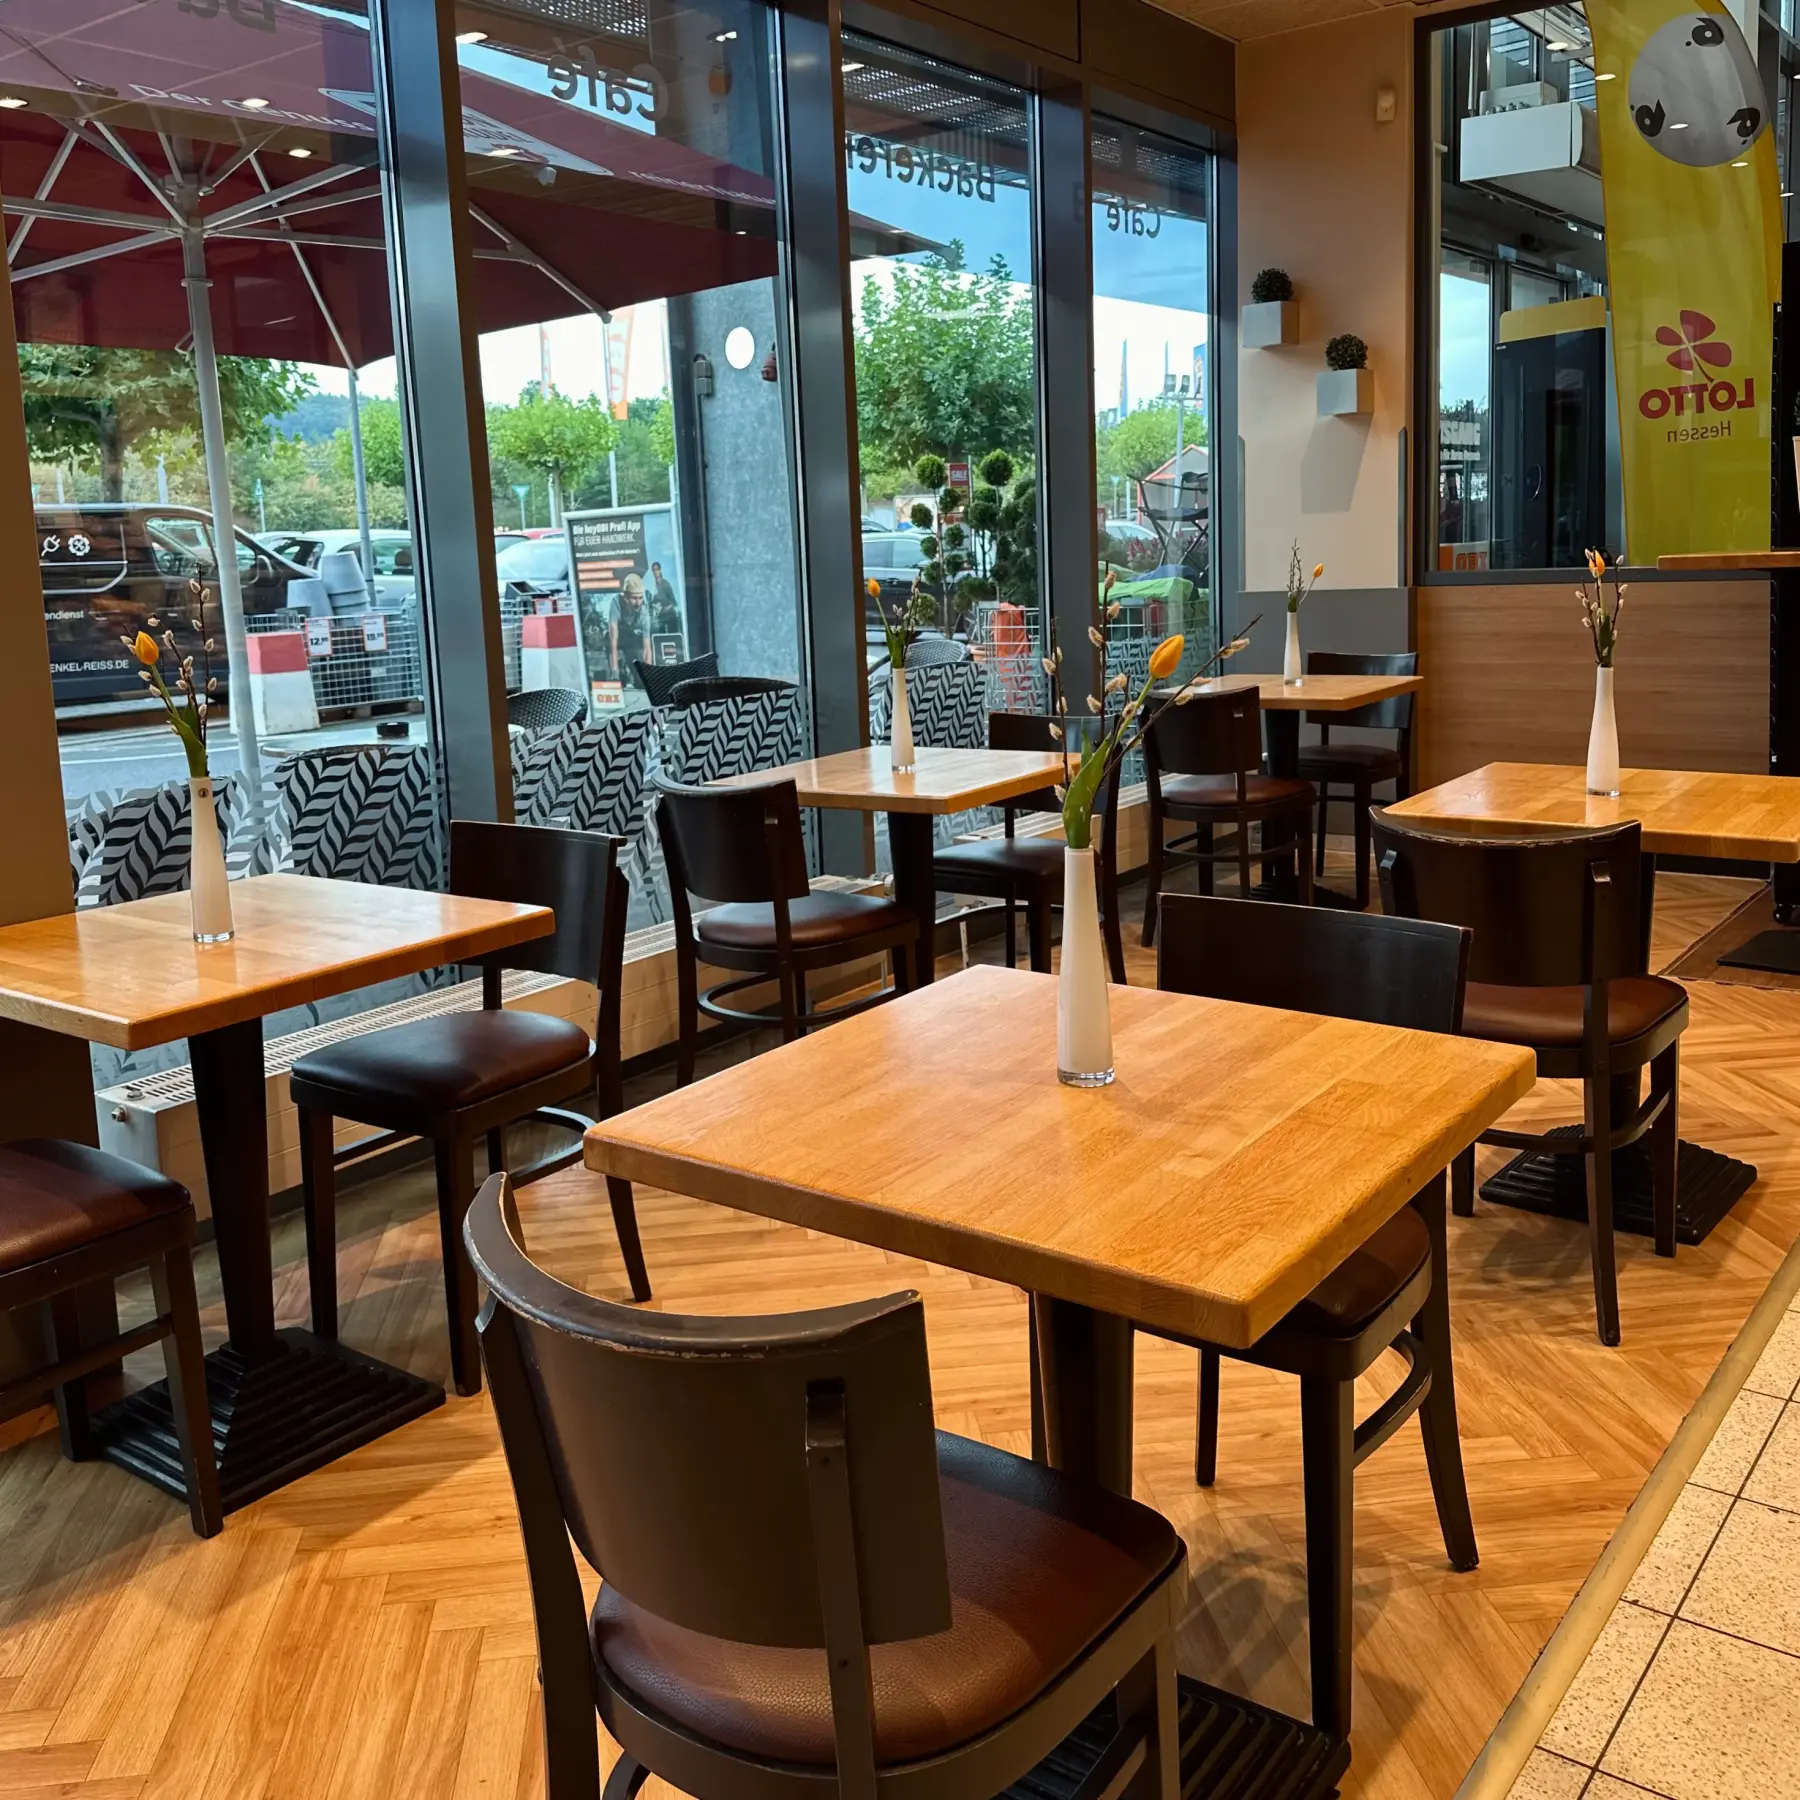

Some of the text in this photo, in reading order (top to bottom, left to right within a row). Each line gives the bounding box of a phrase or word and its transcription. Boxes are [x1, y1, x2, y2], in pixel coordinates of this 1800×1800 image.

[128, 83, 375, 132] Der Genuss
[609, 521, 627, 532] Profi
[627, 520, 641, 532] App
[44, 610, 84, 620] endienst
